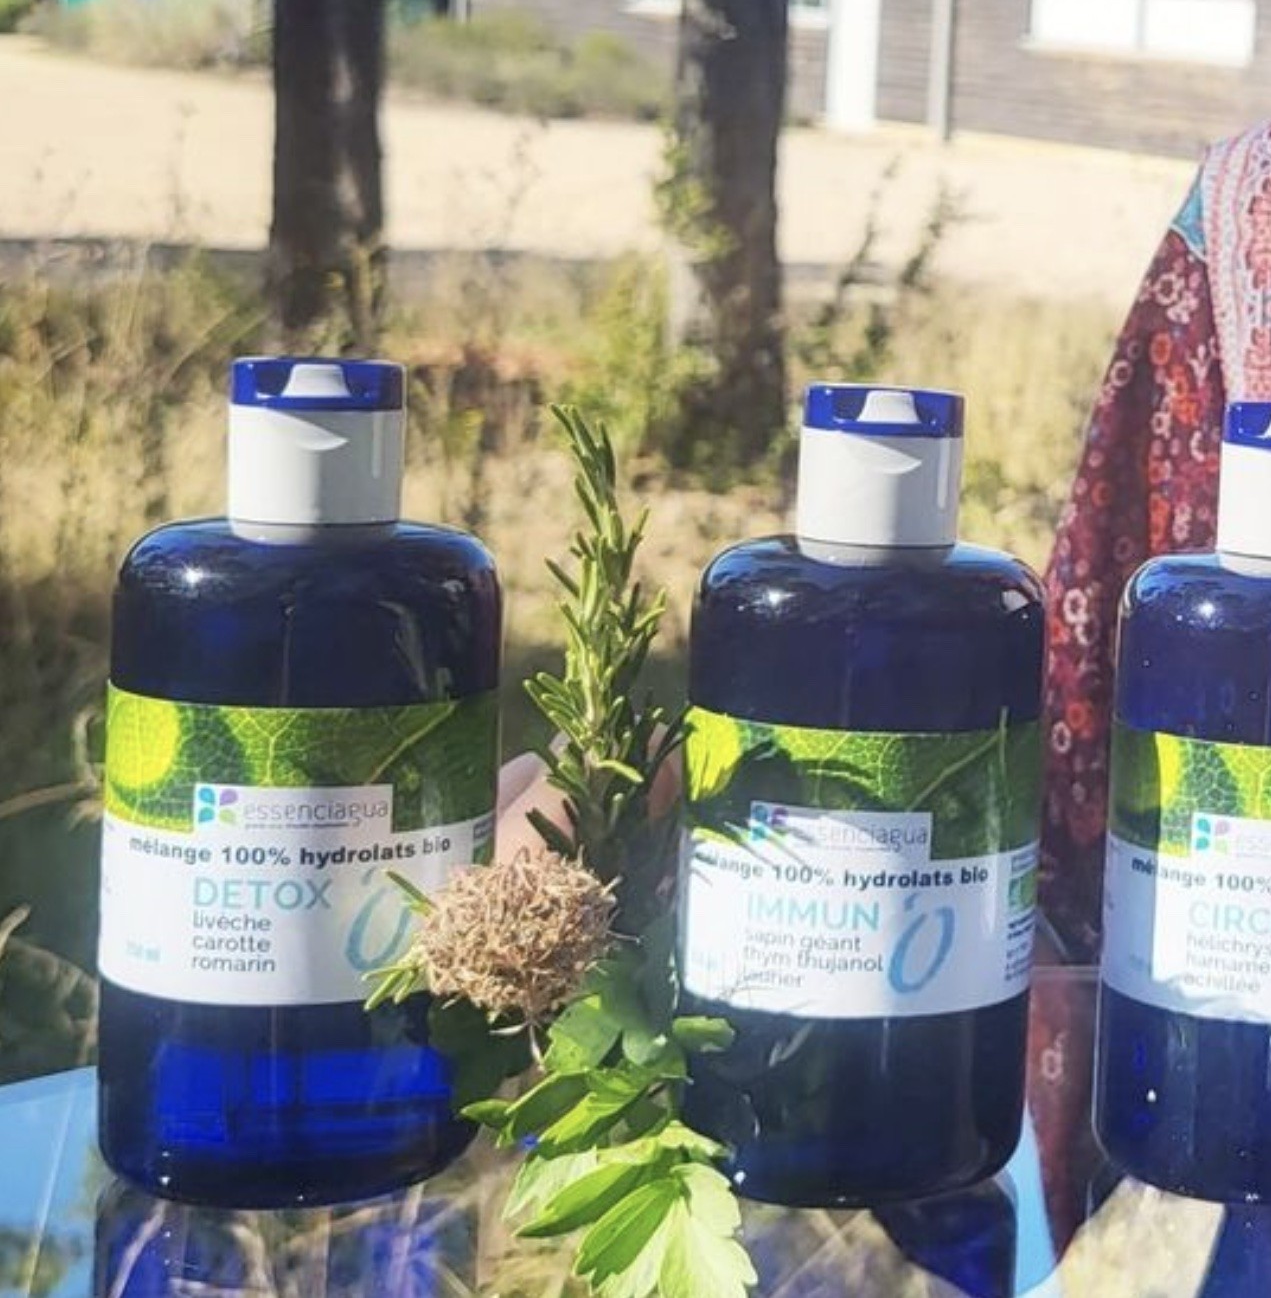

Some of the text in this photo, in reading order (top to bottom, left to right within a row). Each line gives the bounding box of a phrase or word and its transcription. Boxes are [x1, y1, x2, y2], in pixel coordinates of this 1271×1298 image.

[129, 835, 452, 869] mélange 100% hydrolats bio
[771, 863, 835, 885] 100%
[842, 867, 954, 892] hydrolats
[959, 865, 989, 884] bio
[192, 876, 334, 911] DETOX
[747, 893, 881, 932] IMMUN
[192, 934, 272, 953] carotte
[799, 932, 861, 954] géant
[191, 954, 276, 974] romarin
[743, 945, 793, 969] thym
[796, 949, 884, 975] thujanol
